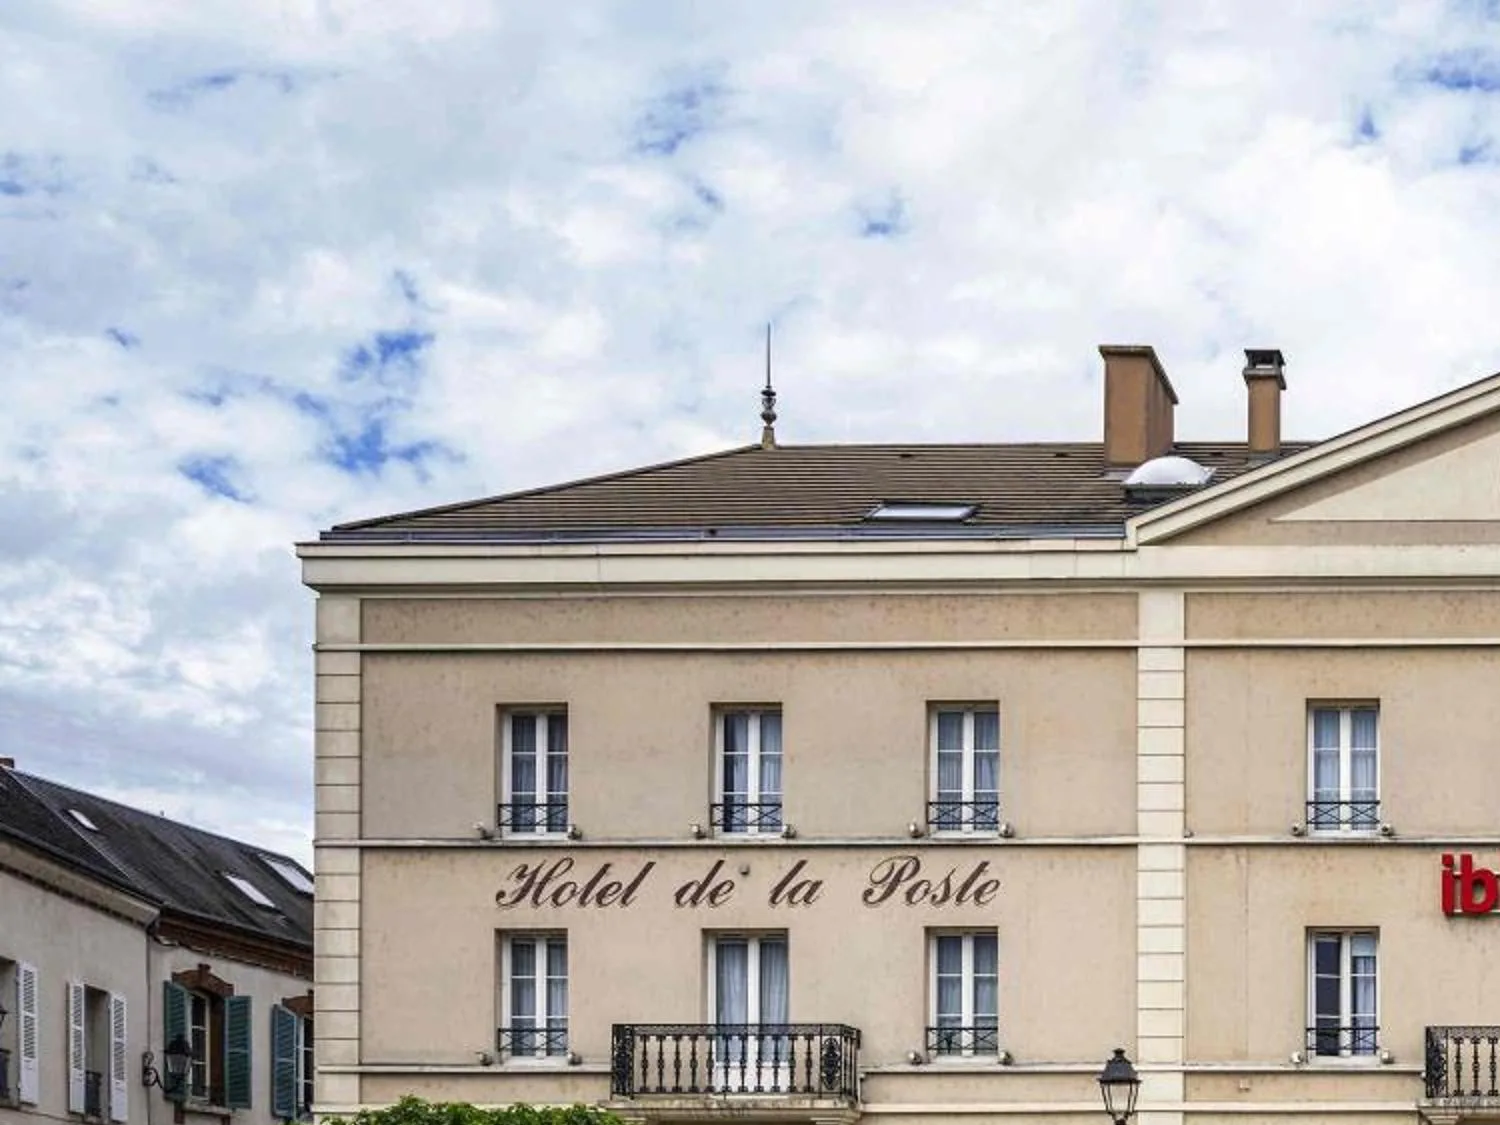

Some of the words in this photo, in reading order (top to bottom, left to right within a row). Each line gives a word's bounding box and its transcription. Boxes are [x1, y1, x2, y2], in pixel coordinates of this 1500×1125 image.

[673, 859, 735, 909] de
[768, 859, 824, 907] la
[862, 855, 1001, 908] Poste
